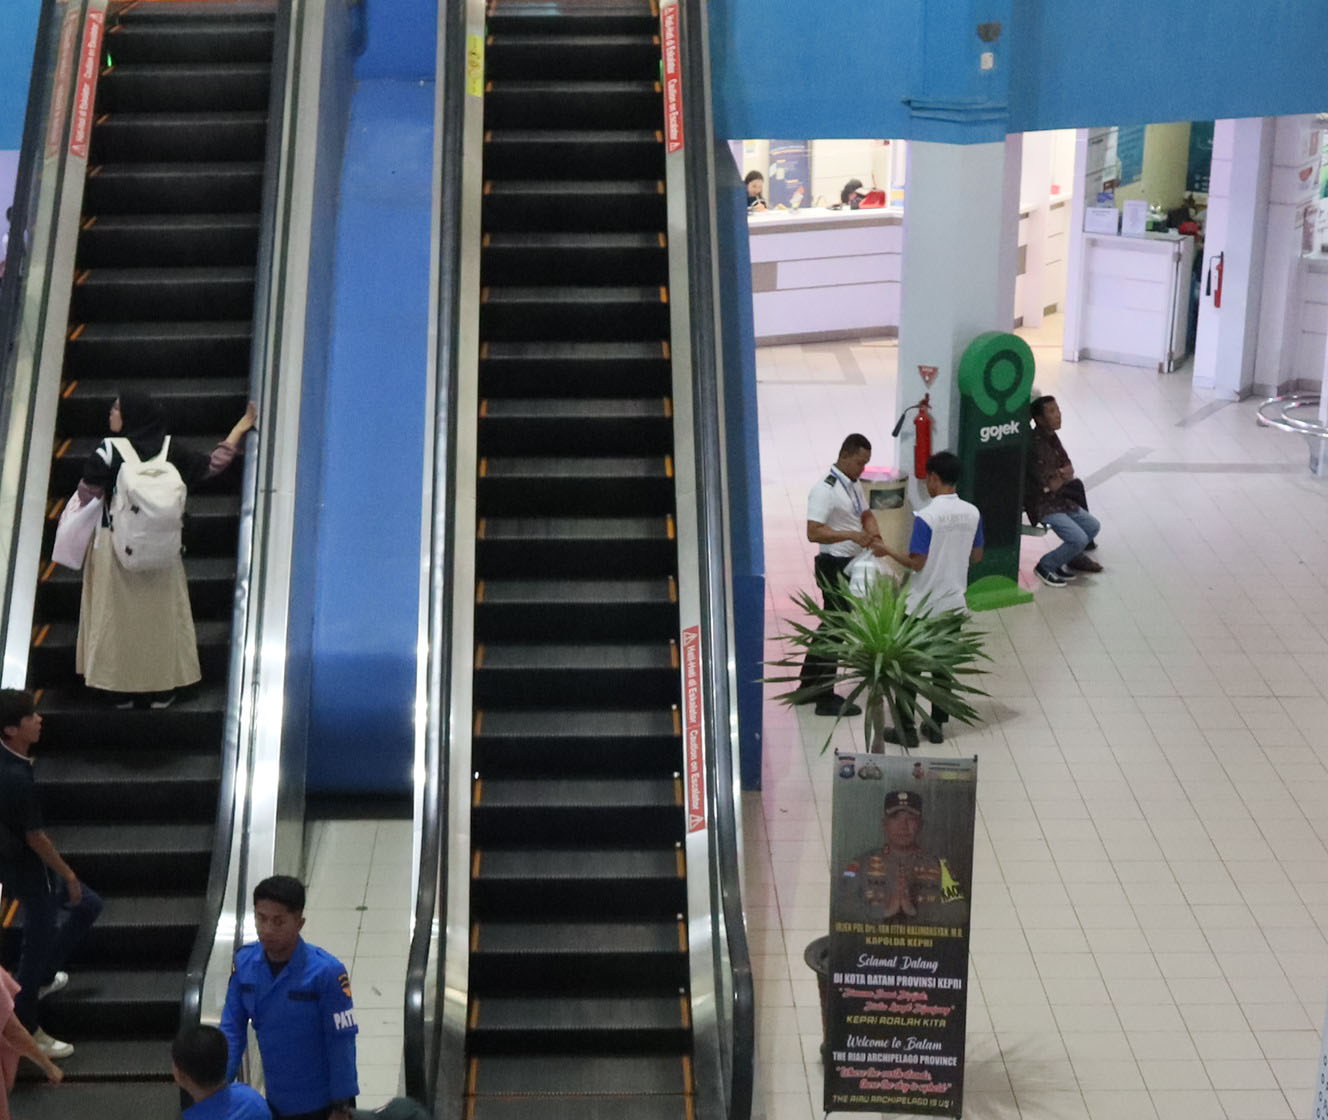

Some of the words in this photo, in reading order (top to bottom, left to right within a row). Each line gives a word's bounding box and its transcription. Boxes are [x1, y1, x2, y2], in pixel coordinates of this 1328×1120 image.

[980, 420, 1020, 442] gojek
[690, 729, 699, 759] Caution
[691, 773, 700, 810] Escalator
[865, 936, 905, 947] KAPOLDA
[907, 938, 933, 947] KEPRI
[856, 953, 898, 969] Selamat
[900, 956, 938, 973] Datang
[833, 973, 843, 984] DI
[844, 974, 865, 985] KOTA
[867, 974, 895, 986] BATAM
[896, 977, 936, 988] PROVINSI
[938, 978, 962, 989] KEPRI
[333, 1009, 356, 1030] PAT
[846, 1015, 878, 1025] KEPRI
[880, 1016, 921, 1026] ADALAH
[923, 1018, 947, 1027] KITA
[846, 1034, 889, 1048] Welcome
[892, 1035, 901, 1048] to
[903, 1037, 942, 1051] Batam
[833, 1052, 846, 1061] THE
[848, 1052, 866, 1062] RIAU
[867, 1053, 918, 1064] ARCHIPELAGO
[920, 1055, 957, 1066] PROVINCE
[833, 1095, 848, 1103] THE
[848, 1095, 869, 1104] RIAU
[870, 1096, 928, 1106] ARCHIPELAGO
